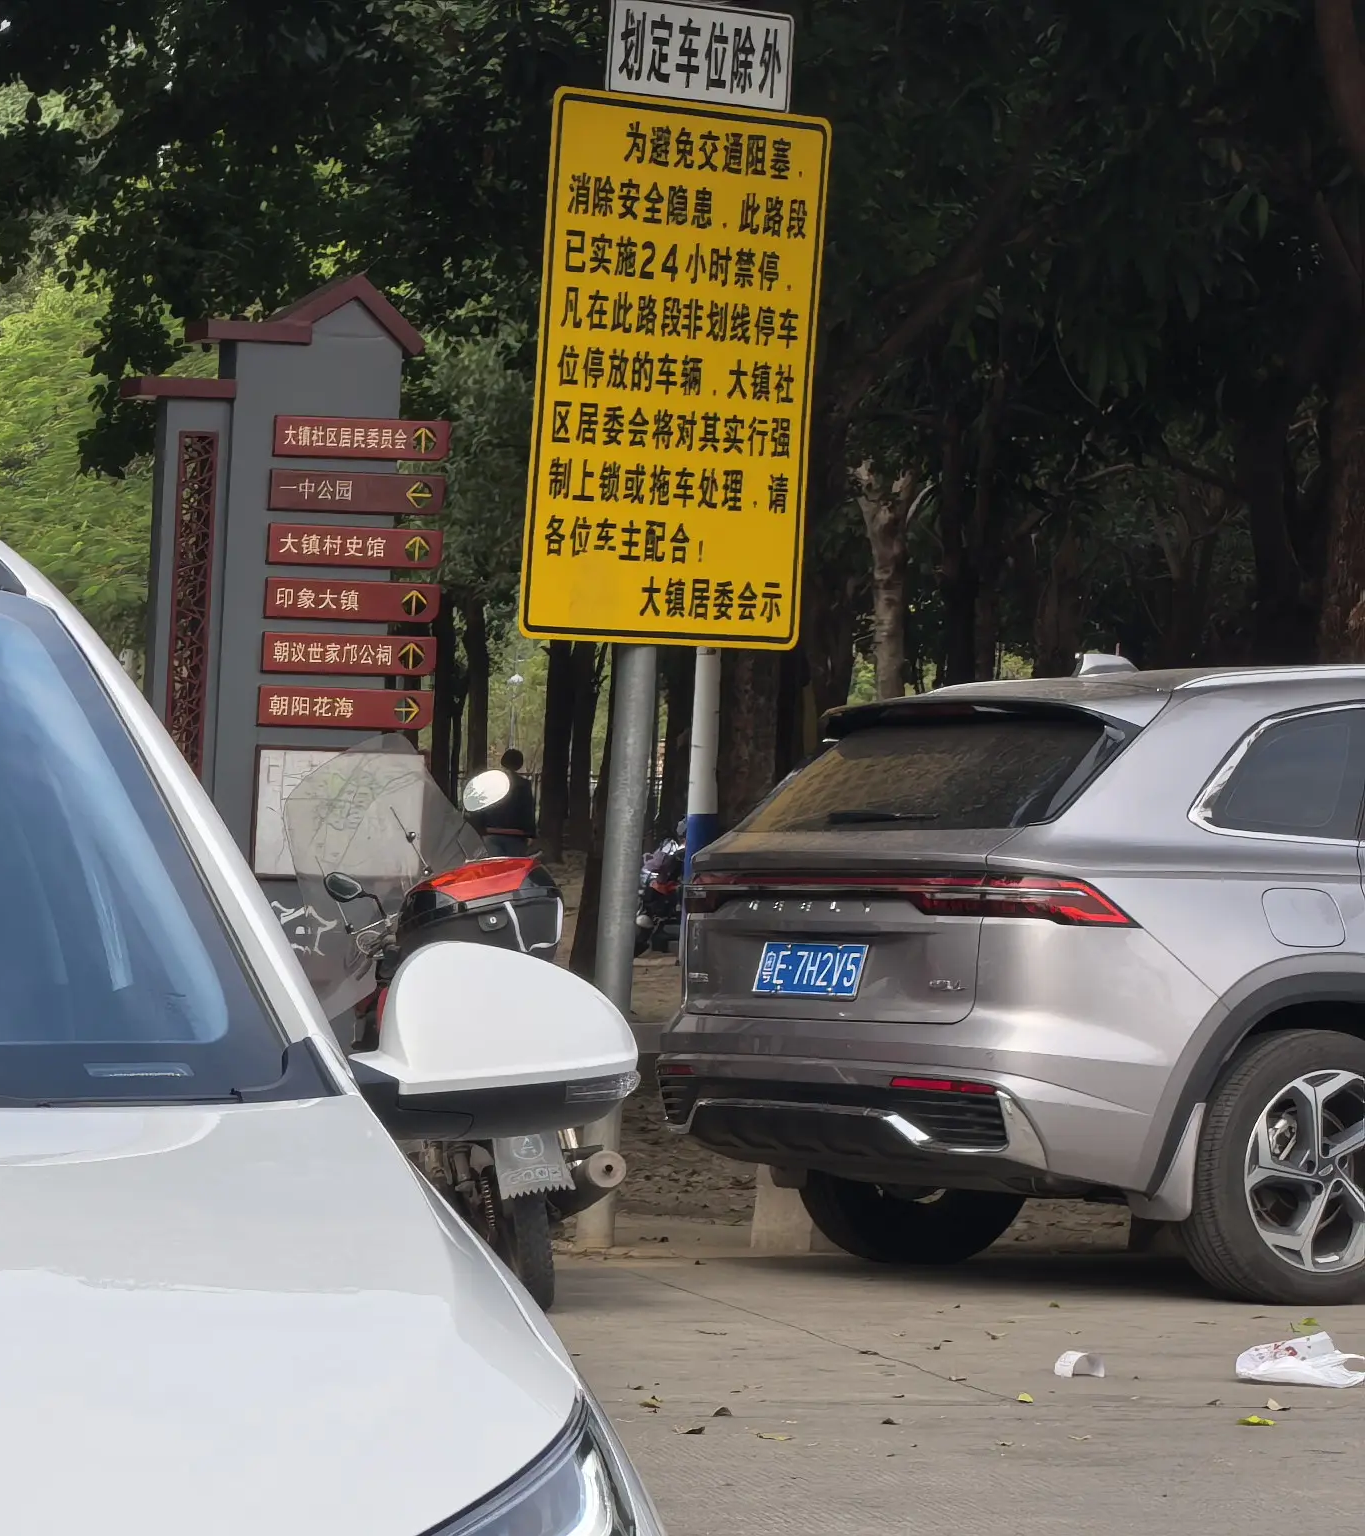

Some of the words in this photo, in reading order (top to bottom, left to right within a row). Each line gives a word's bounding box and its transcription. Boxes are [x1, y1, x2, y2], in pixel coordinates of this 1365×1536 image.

[619, 9, 782, 98] 划定车位除外
[561, 286, 799, 349] 凡在此路段非划线停车
[283, 425, 408, 450] 大镇社区居民委员会
[552, 401, 791, 458] 区居委会将对其实行强
[279, 478, 353, 501] 一中公园
[279, 532, 387, 558] 大镇村史馆
[275, 587, 360, 611] 印象大镇
[639, 576, 782, 623] 大镇居委会示
[269, 694, 354, 719] 朝阳花海
